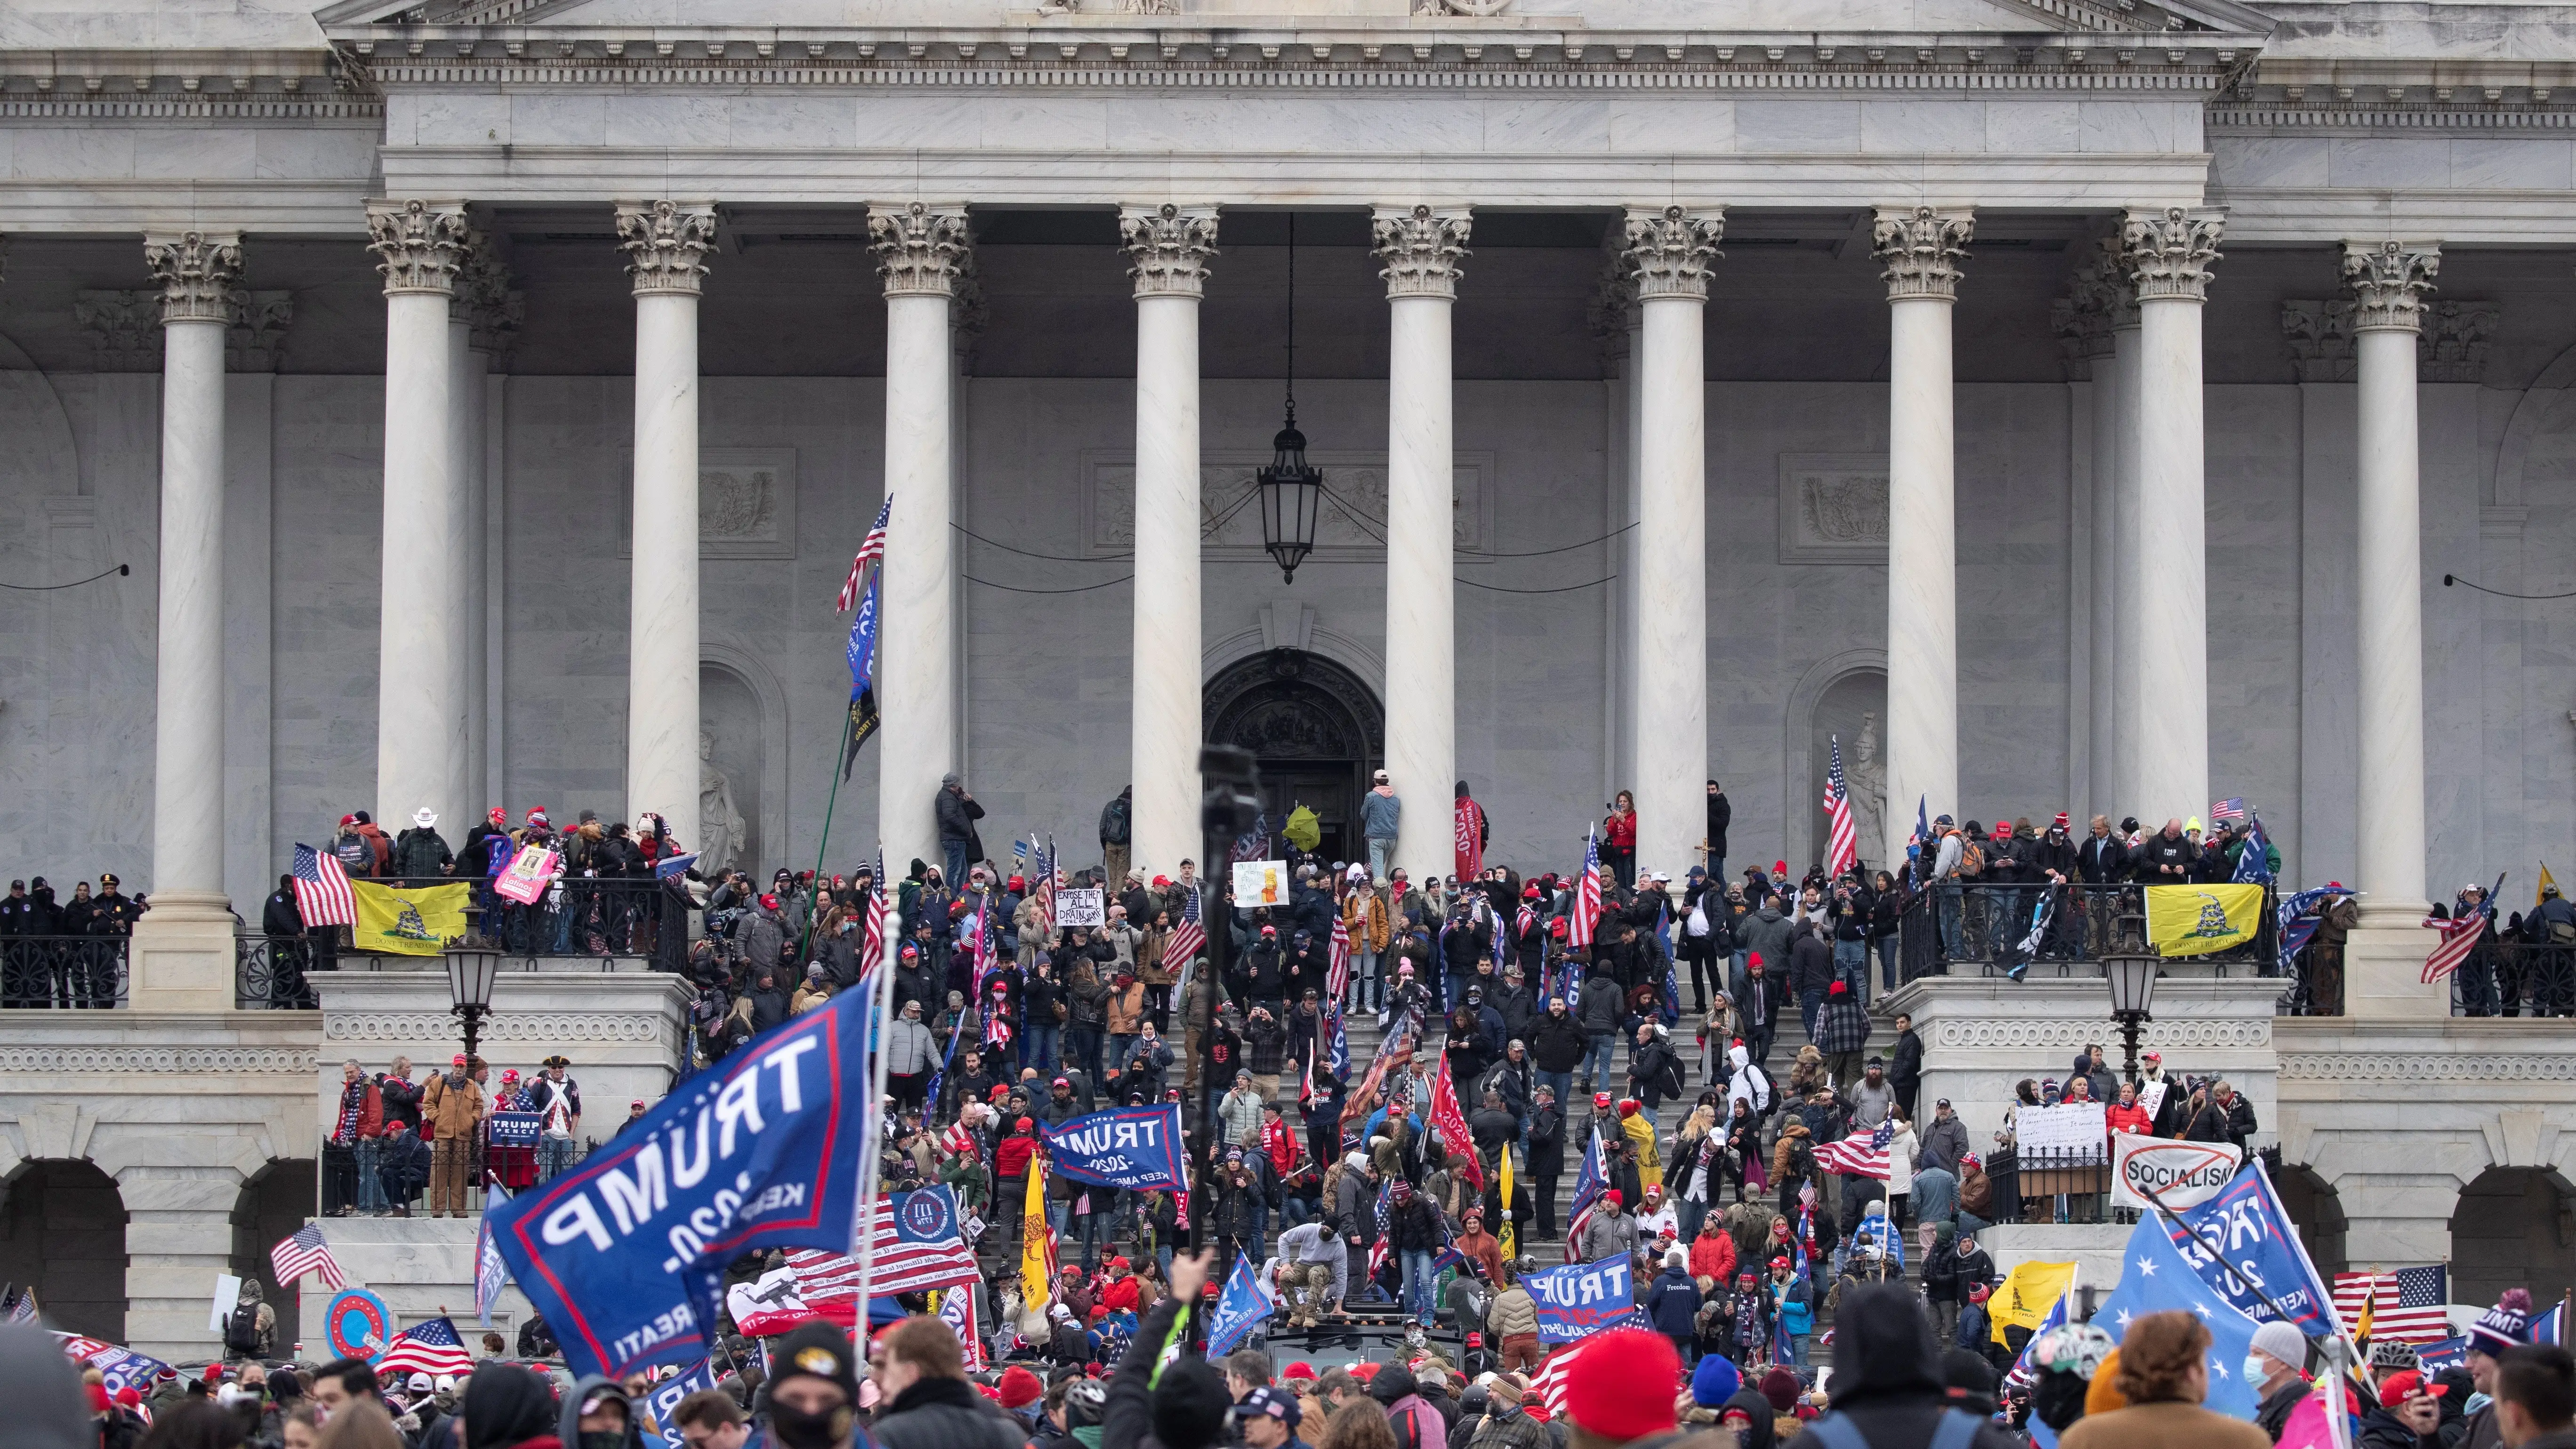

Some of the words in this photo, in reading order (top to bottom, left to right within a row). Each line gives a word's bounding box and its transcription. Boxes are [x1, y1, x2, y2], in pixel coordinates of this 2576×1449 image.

[504, 877, 533, 891] Latinos
[1058, 891, 1083, 899] EXPOSE
[1085, 890, 1102, 899] THEM
[1060, 910, 1084, 919] DRAIN
[1079, 908, 1101, 925] SWAMP
[2149, 1089, 2162, 1114] STEAL
[492, 1120, 539, 1128] TRUMP
[2128, 1161, 2232, 1187] SOCIALISM
[953, 1289, 967, 1304] EEP
[1028, 1284, 1035, 1299] ME
[2479, 1311, 2524, 1333] UMP
